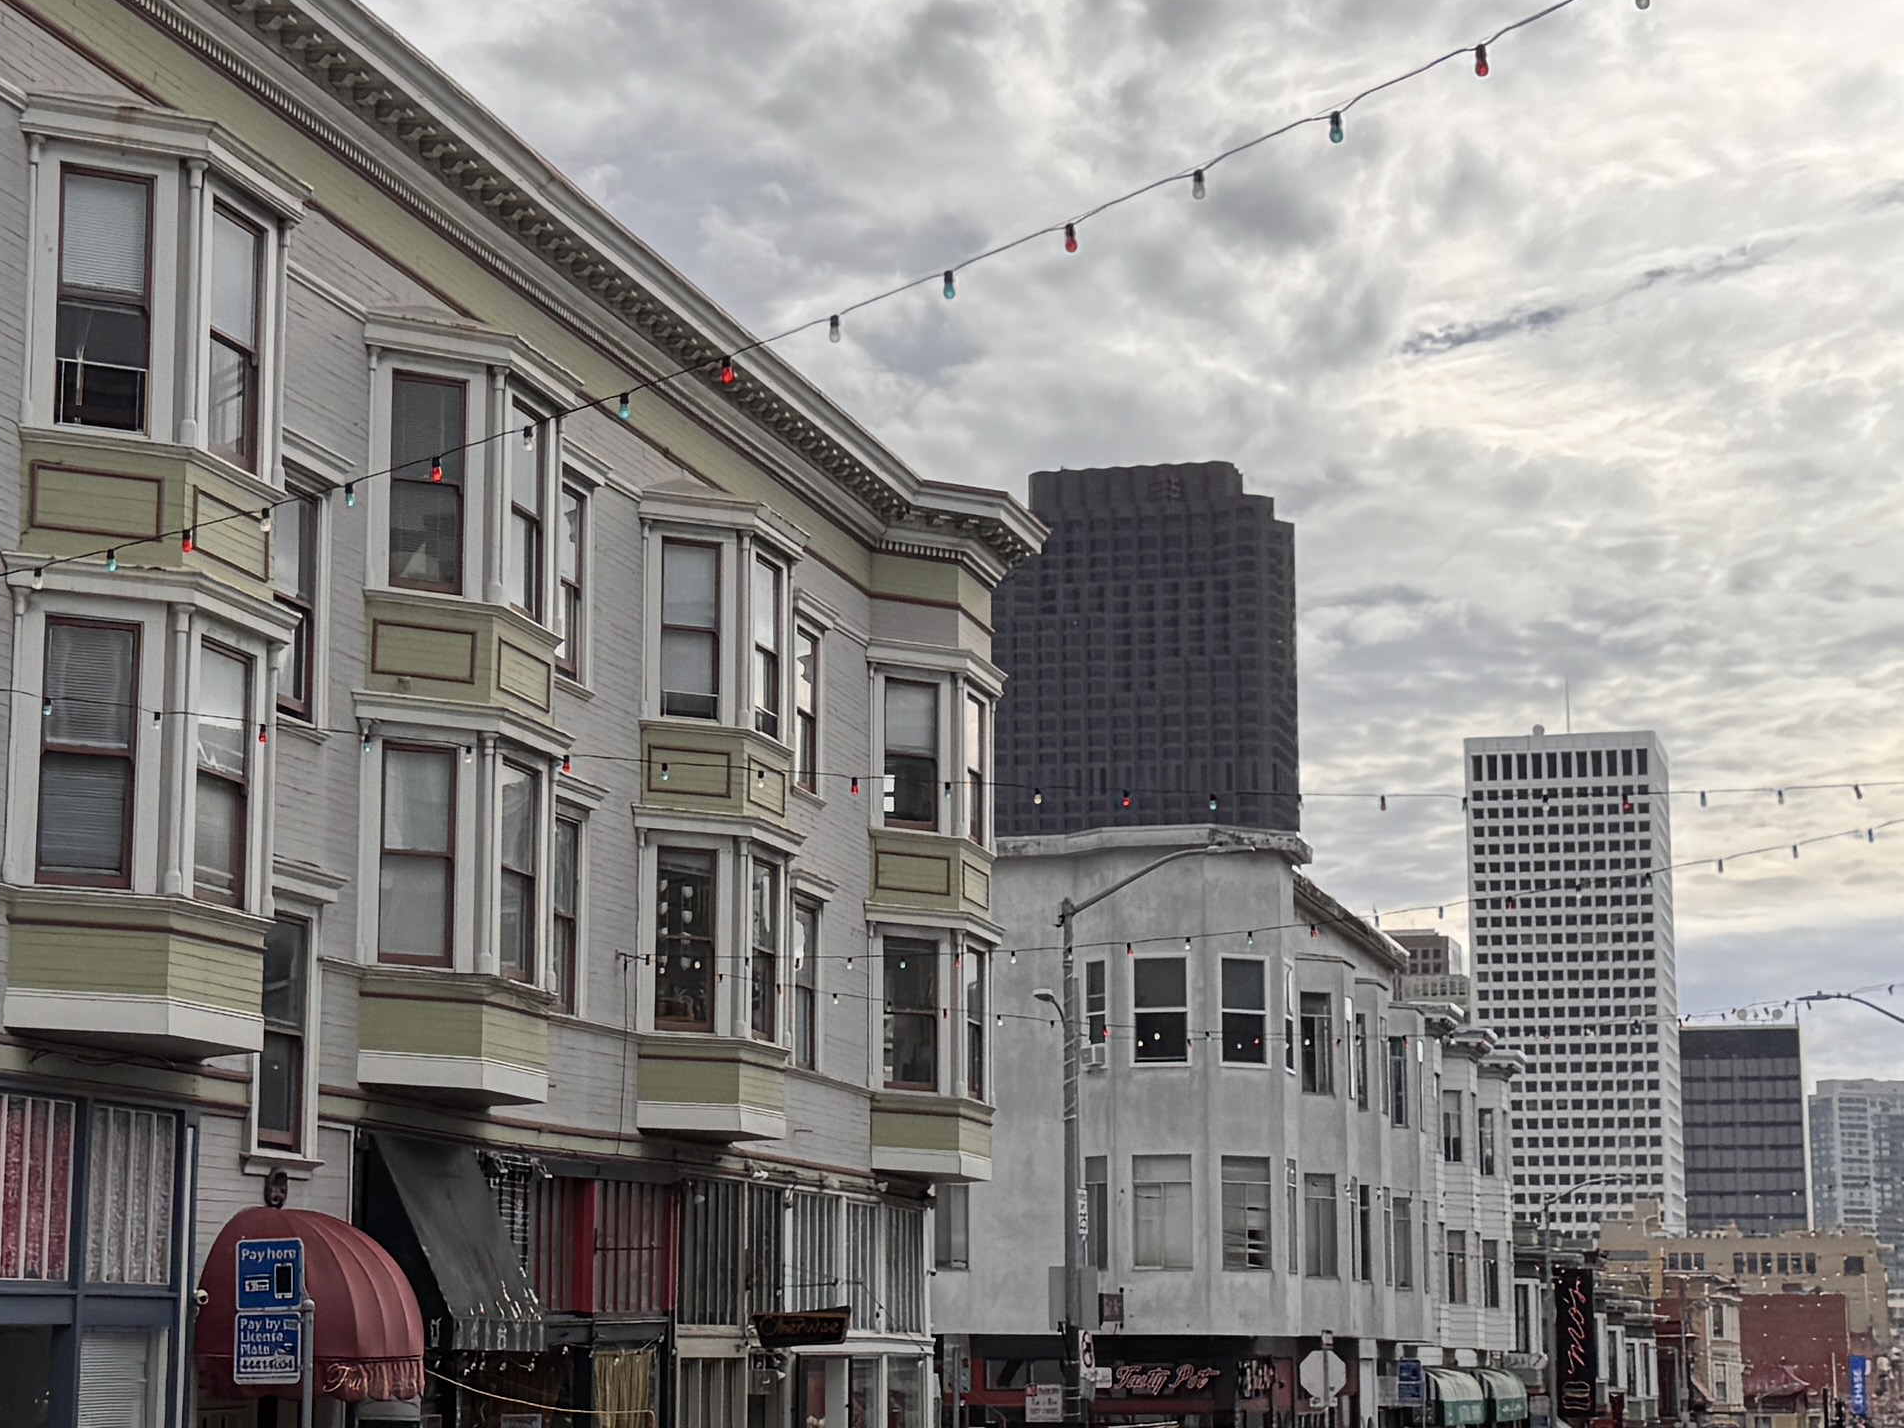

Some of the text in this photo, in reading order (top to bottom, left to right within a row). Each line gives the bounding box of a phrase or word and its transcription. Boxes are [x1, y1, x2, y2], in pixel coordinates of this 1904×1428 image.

[241, 1247, 297, 1263] Pay here
[240, 1316, 281, 1332] Pay by
[240, 1331, 284, 1343] License
[240, 1343, 271, 1356] Plate
[1112, 1365, 1171, 1397] Tasty
[1168, 1363, 1221, 1390] Pot
